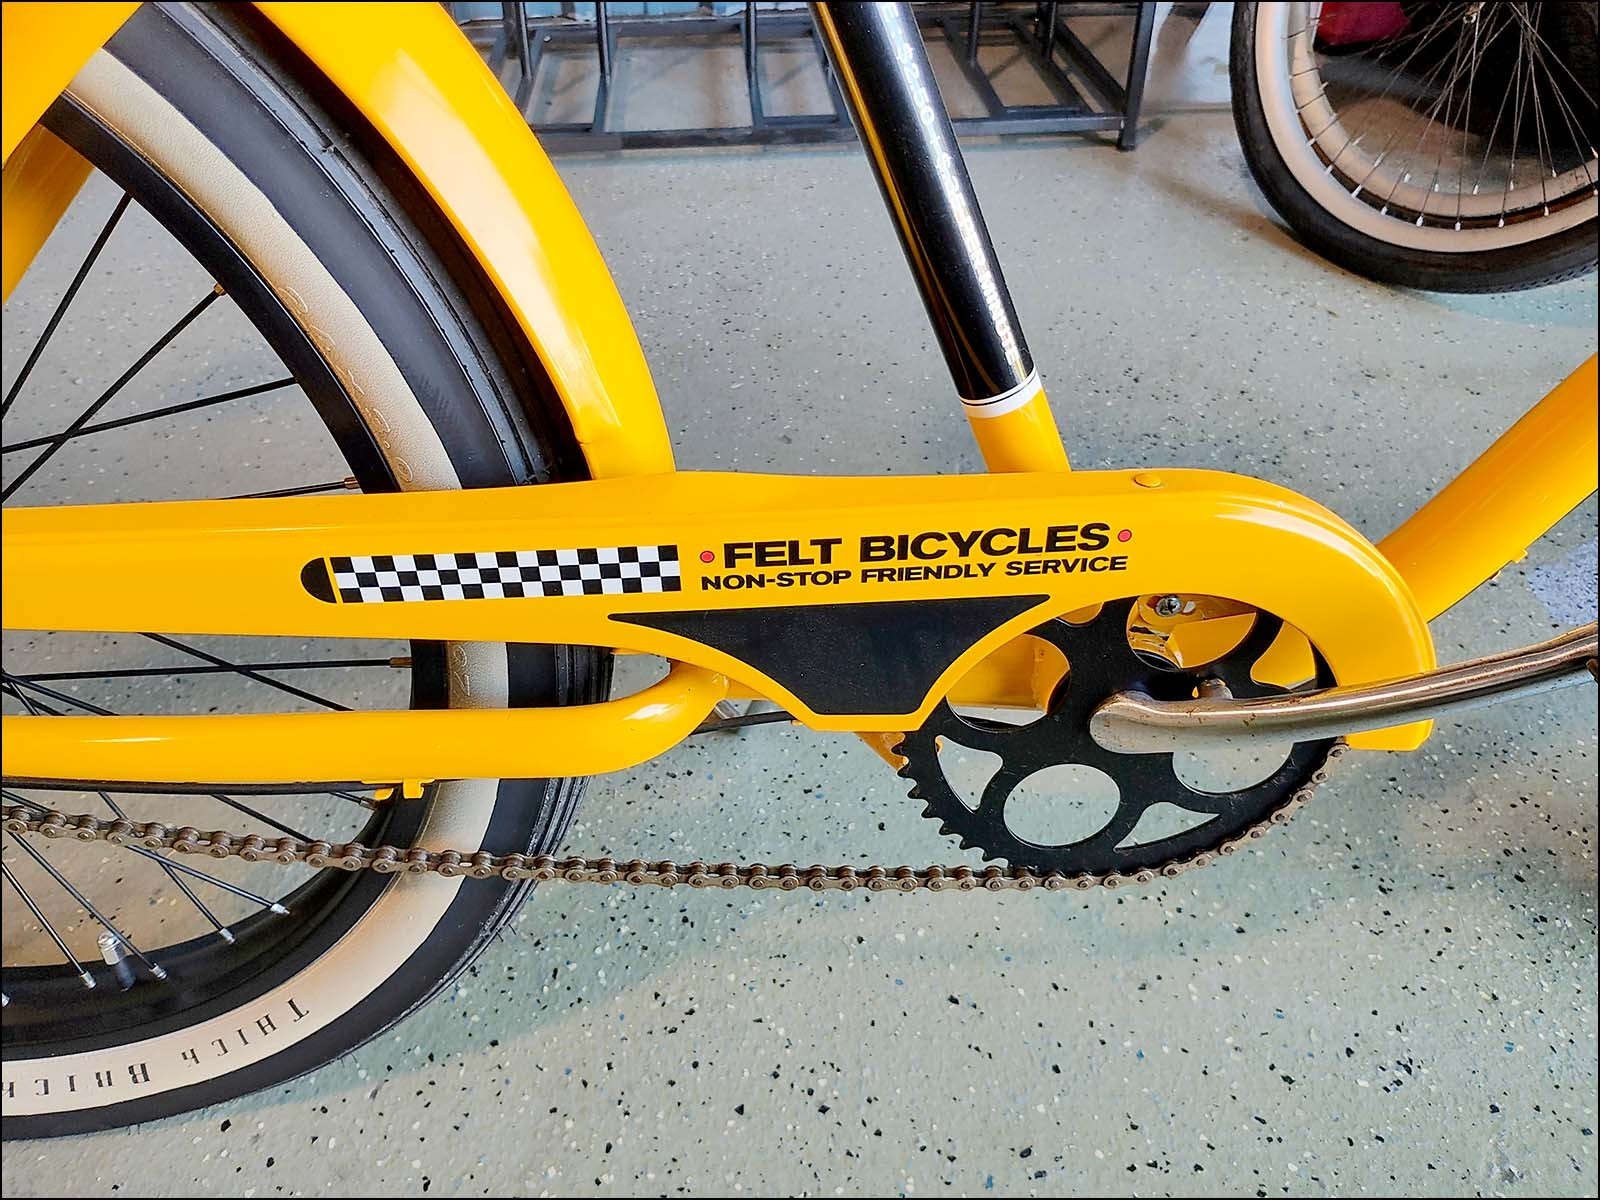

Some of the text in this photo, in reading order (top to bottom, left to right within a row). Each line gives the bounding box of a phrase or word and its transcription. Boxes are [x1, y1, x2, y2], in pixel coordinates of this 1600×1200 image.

[723, 522, 1111, 569] FELT BICYCLES
[701, 556, 1128, 591] NON-STOP FRIENDLY SERVICE
